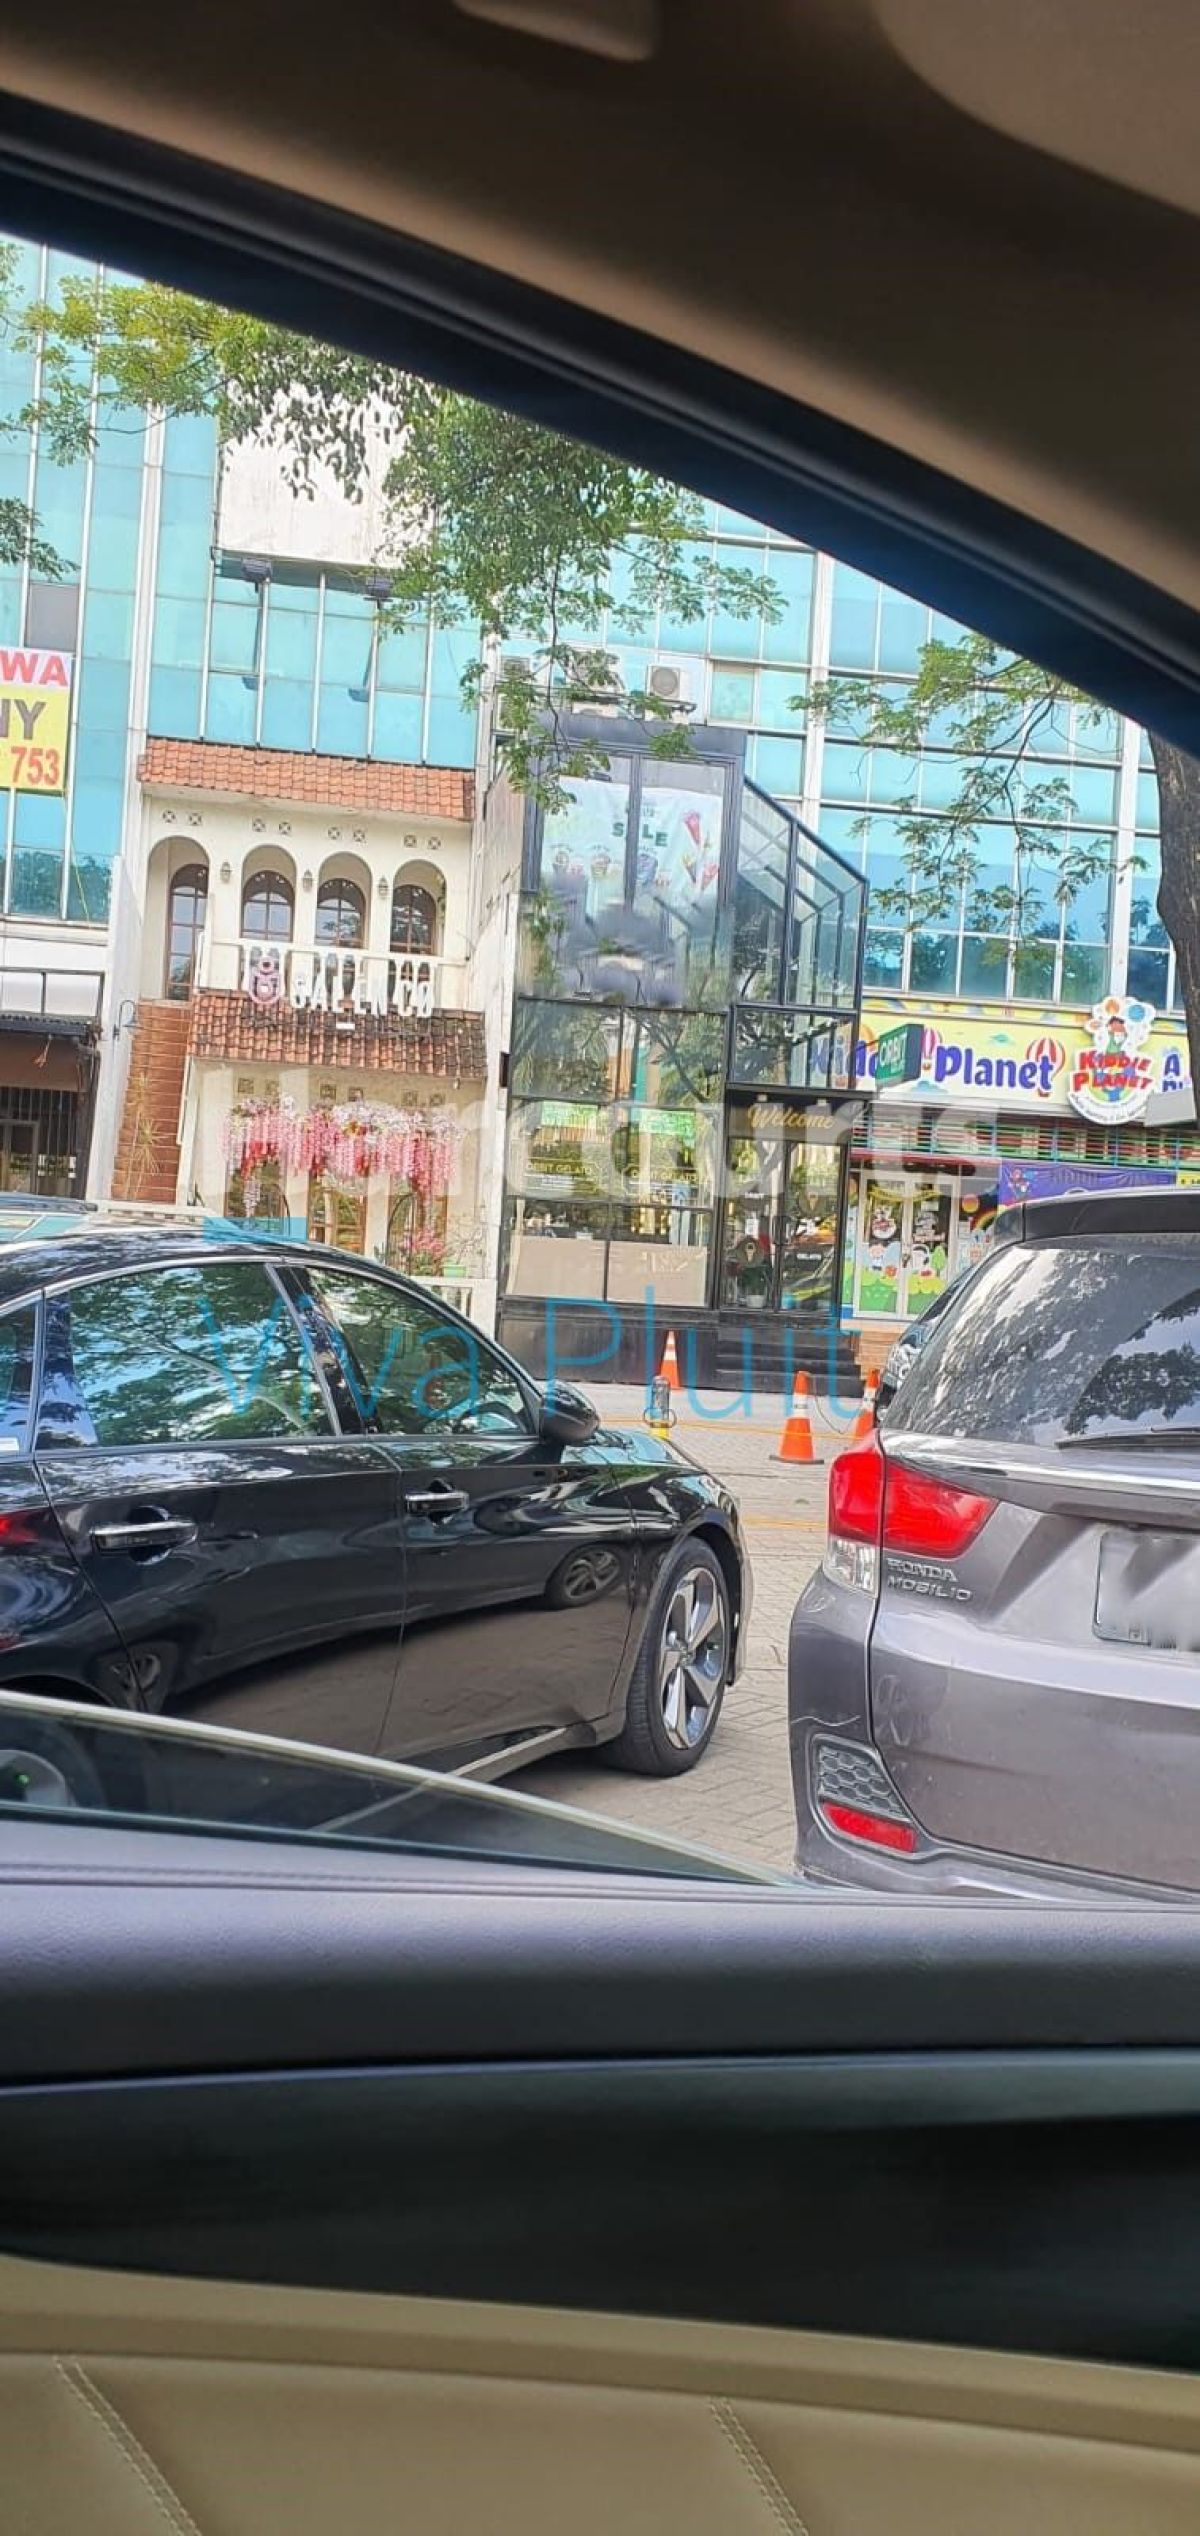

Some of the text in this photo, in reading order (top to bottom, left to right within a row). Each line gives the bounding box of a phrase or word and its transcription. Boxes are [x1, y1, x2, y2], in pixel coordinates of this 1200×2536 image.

[611, 822, 668, 847] SLE
[935, 1045, 1053, 1090] Planet
[748, 1105, 836, 1129] Welcome
[887, 1557, 958, 1583] HONDA
[887, 1575, 973, 1600] MOBILIO
